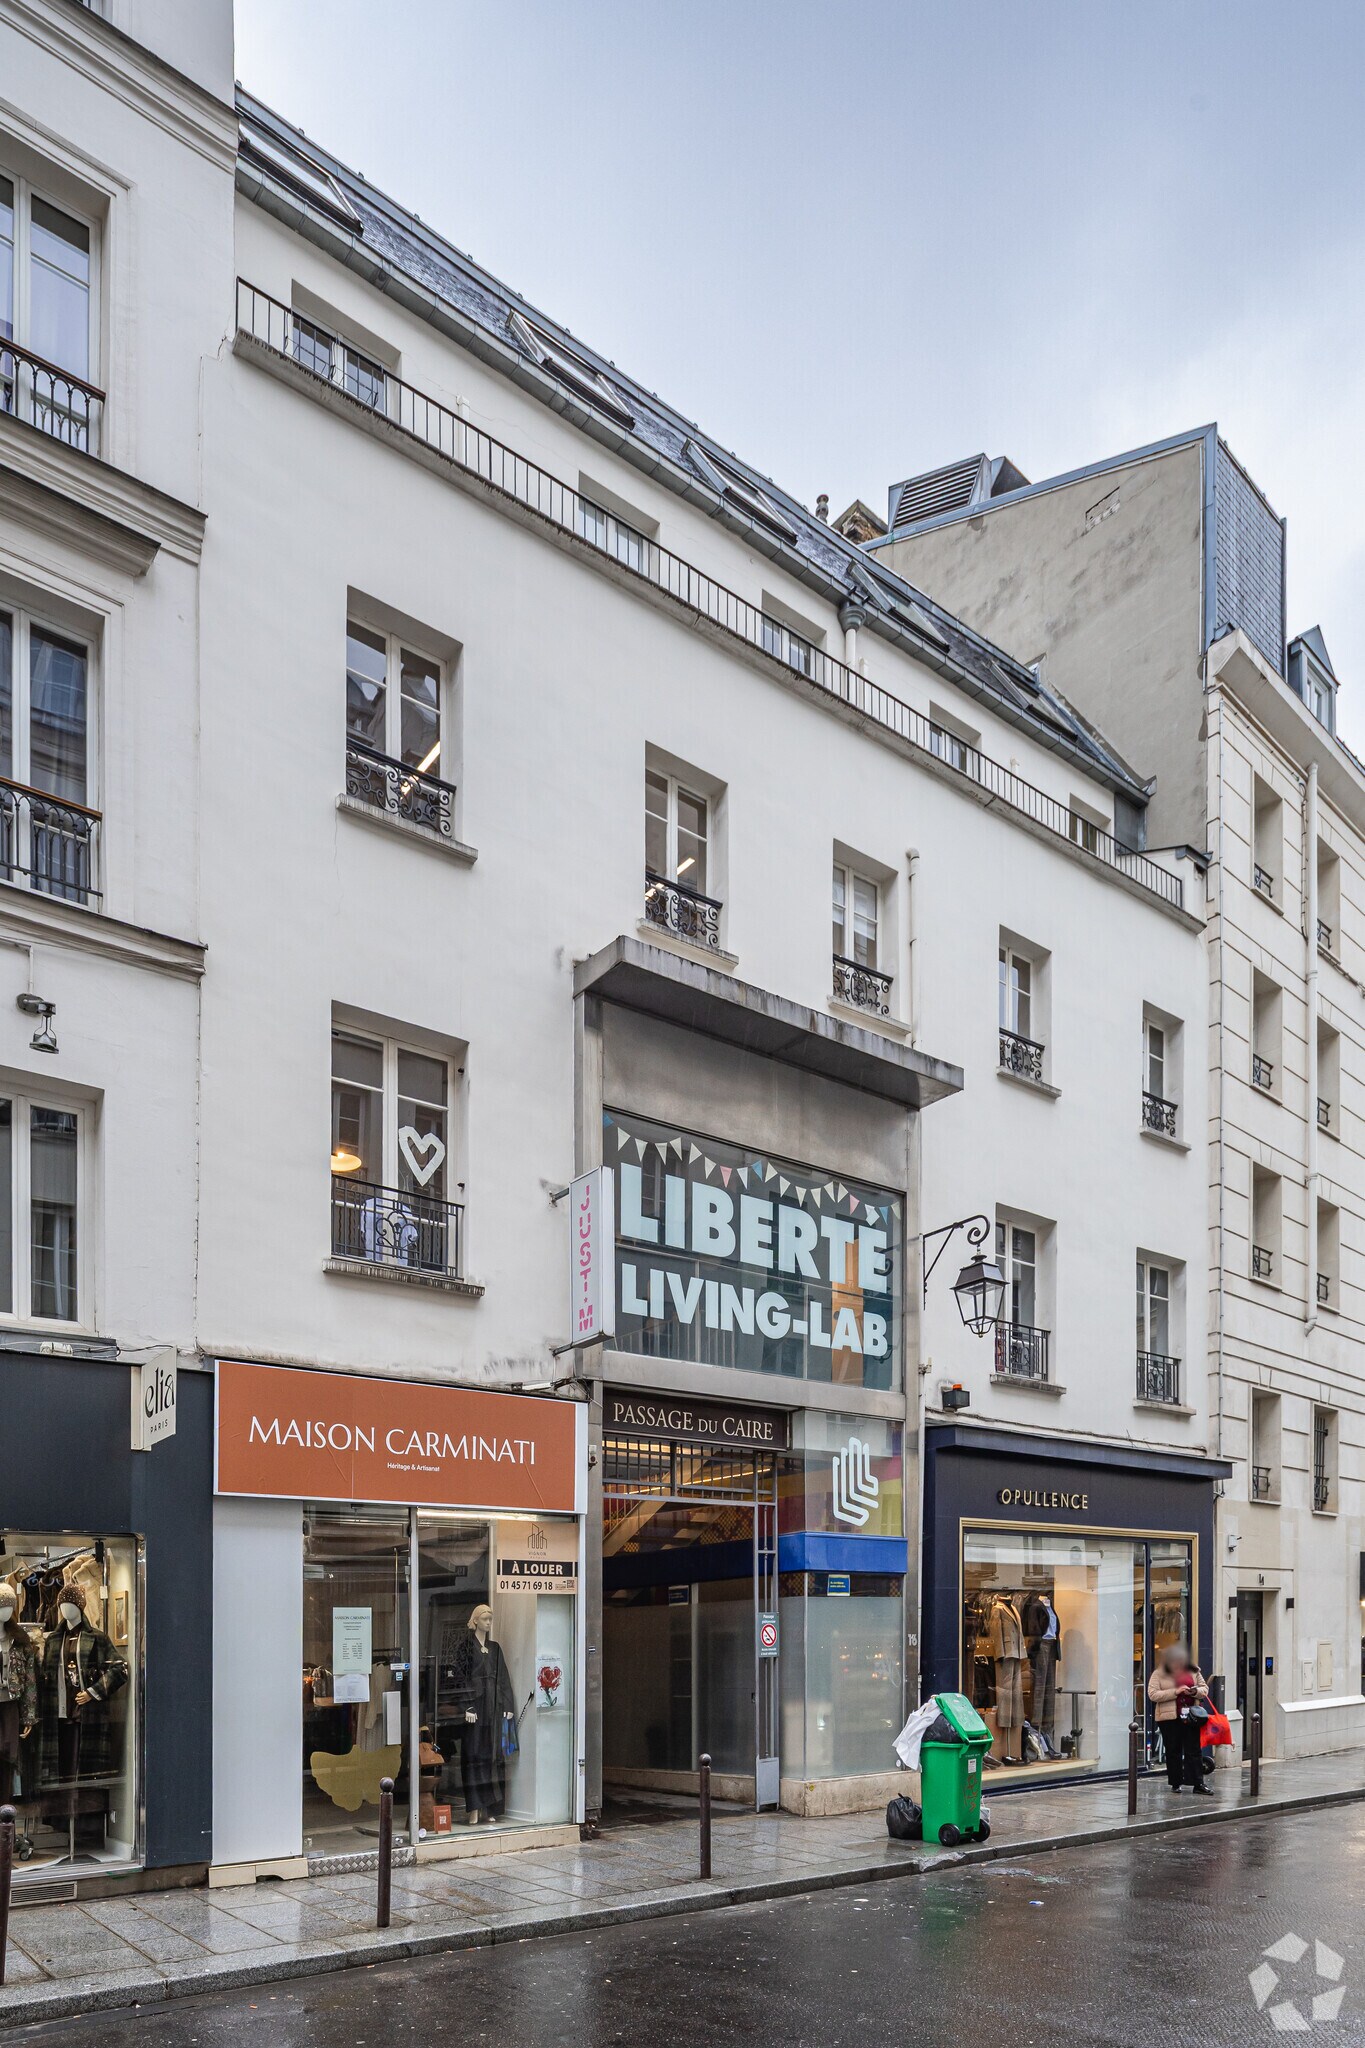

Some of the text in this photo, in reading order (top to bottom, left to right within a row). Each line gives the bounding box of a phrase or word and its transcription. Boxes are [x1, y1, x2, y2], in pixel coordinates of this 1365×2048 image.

[620, 1162, 888, 1294] LIBERTÉ
[621, 1262, 888, 1357] LIVING-LAB
[144, 1366, 175, 1418] elia
[150, 1418, 168, 1433] PARIS
[613, 1402, 774, 1441] PASSAGE DU CAIRE
[248, 1415, 536, 1465] MAISON CARMINATI
[387, 1462, 440, 1472] Héritage & Artisanat
[1001, 1488, 1089, 1510] OPULLENCE
[511, 1560, 563, 1575] À LOUER
[500, 1580, 509, 1590] 01
[511, 1580, 521, 1590] 45
[522, 1581, 531, 1590] 71
[532, 1581, 542, 1591] 69
[544, 1581, 553, 1591] 18
